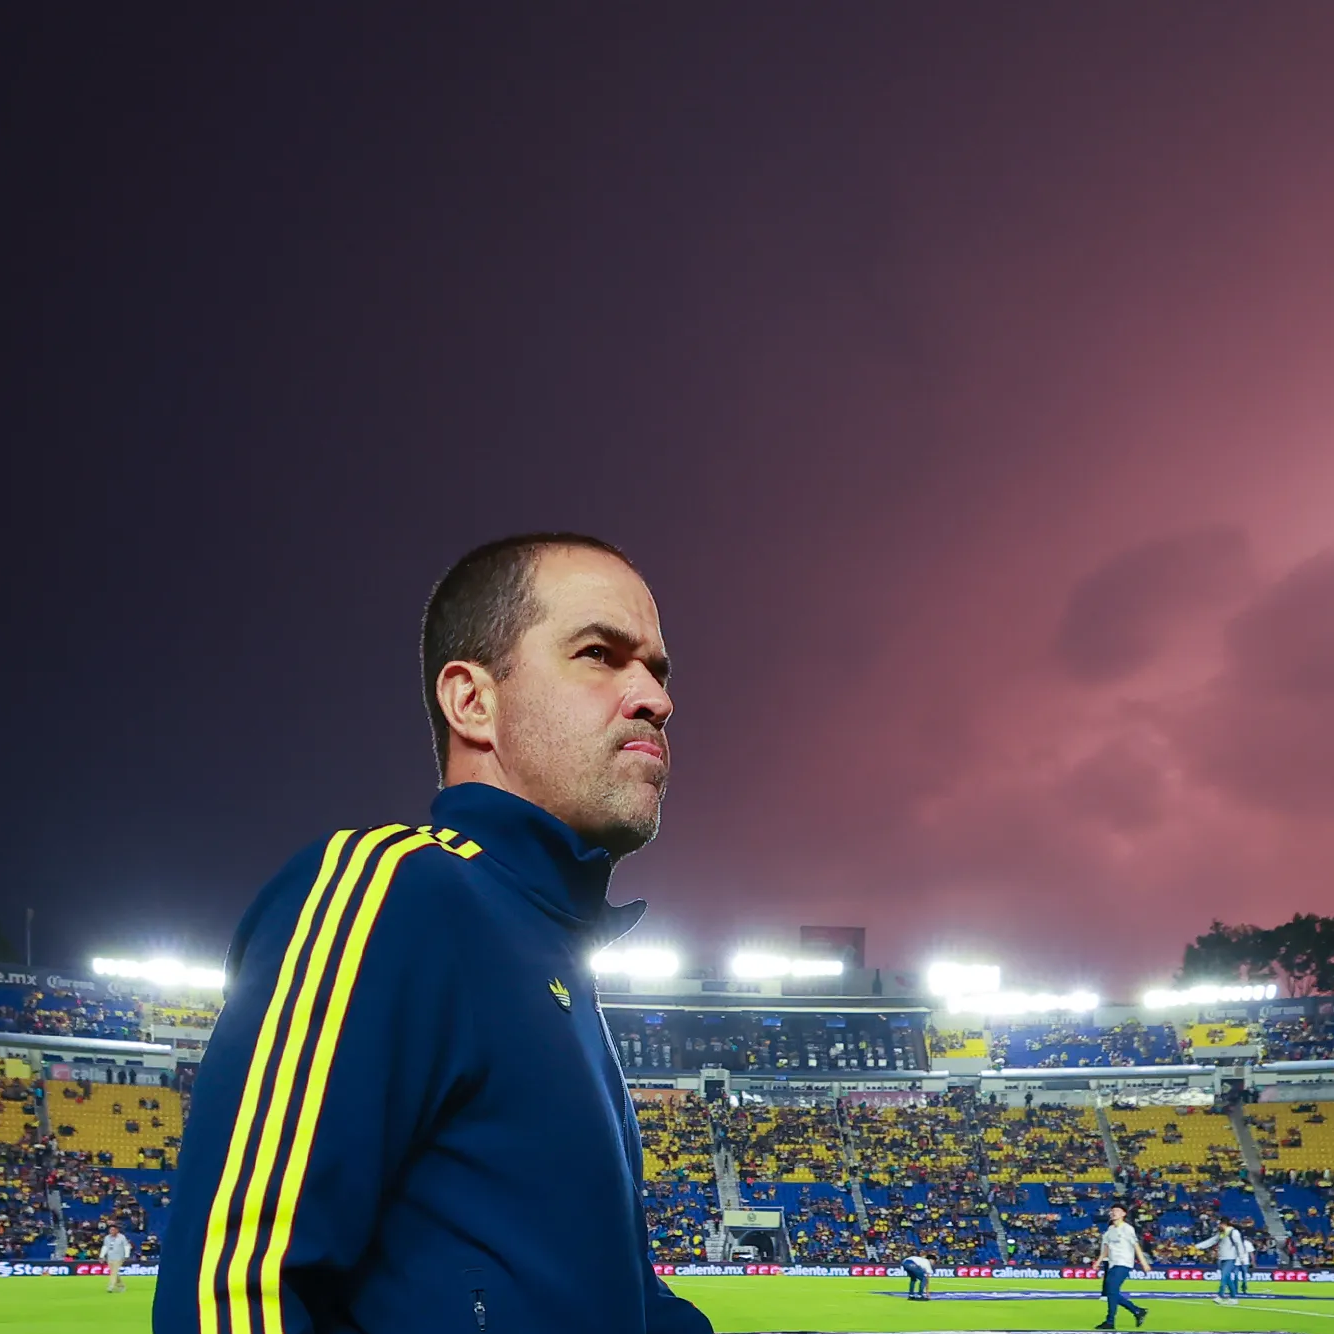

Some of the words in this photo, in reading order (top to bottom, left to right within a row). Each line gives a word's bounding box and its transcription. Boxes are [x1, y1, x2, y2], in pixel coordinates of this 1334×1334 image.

[13, 1262, 69, 1276] Steren
[674, 1264, 744, 1276] caliente.mx
[782, 1264, 849, 1277] caliente.mx
[992, 1267, 1061, 1279] caliente.mx
